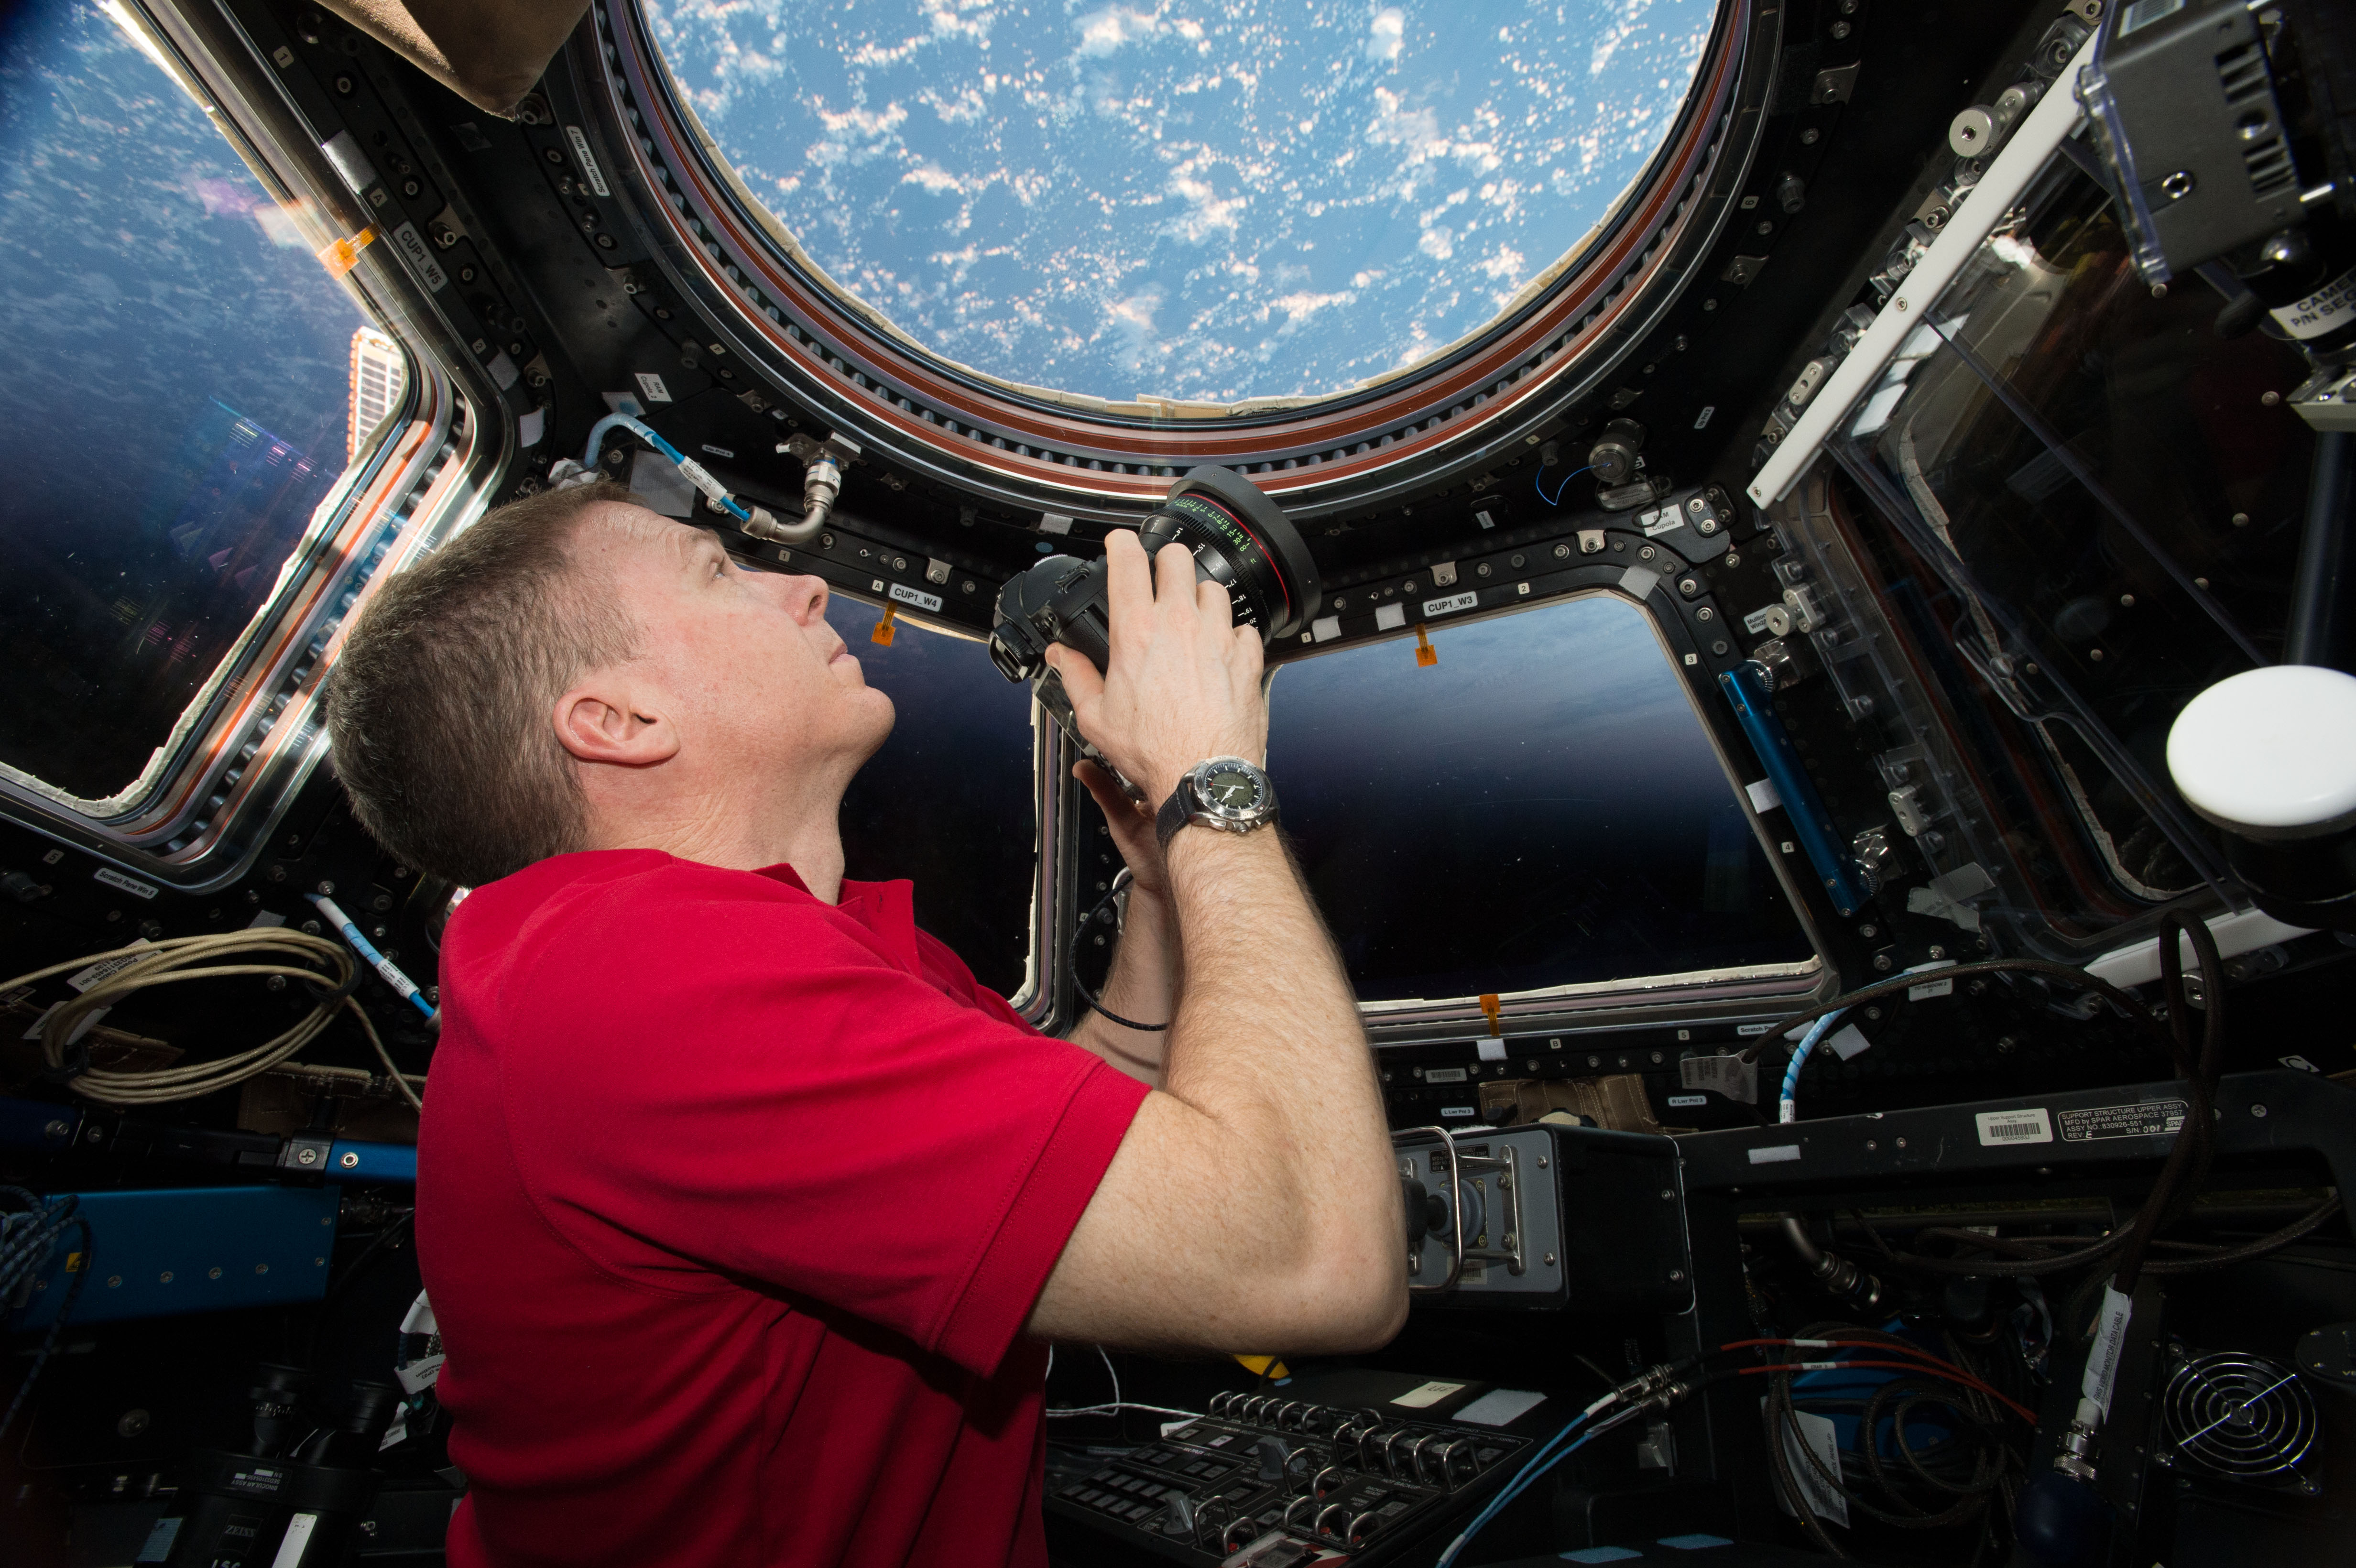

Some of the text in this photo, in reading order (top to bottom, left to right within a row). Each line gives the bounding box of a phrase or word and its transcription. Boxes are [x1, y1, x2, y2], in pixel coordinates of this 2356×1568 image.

[279, 53, 288, 61] 1
[575, 136, 585, 149] Win
[582, 150, 593, 167] Pane
[589, 168, 605, 193] Scratch
[373, 193, 382, 203] A
[402, 230, 441, 285] CUP1_W5
[2291, 312, 2318, 327] P/N
[653, 381, 664, 394] RAM
[1652, 520, 1675, 531] Cupola
[894, 588, 938, 608] CUP1_W4
[1428, 596, 1473, 612] CUP1_W3
[99, 871, 122, 884] Scratch
[123, 880, 137, 889] Pane
[137, 886, 149, 894] Win
[97, 958, 138, 981] Power Cable
[2062, 1111, 2093, 1120] SUPPORT
[2094, 1107, 2136, 1117] STRUCTURE
[2136, 1105, 2162, 1113] UPPER
[2091, 1116, 2110, 1124] SPAR
[2112, 1112, 2160, 1122] AEROSPACE
[2161, 1109, 2183, 1117] 37957
[2085, 1130, 2093, 1139] E
[2112, 1311, 2124, 1331] CABLE
[2109, 1330, 2118, 1347] DATA
[2104, 1344, 2115, 1372] MONITOR
[2099, 1370, 2107, 1388] VIDEO
[246, 1481, 279, 1491] BINOCULAR
[224, 1525, 257, 1538] ZEISS
